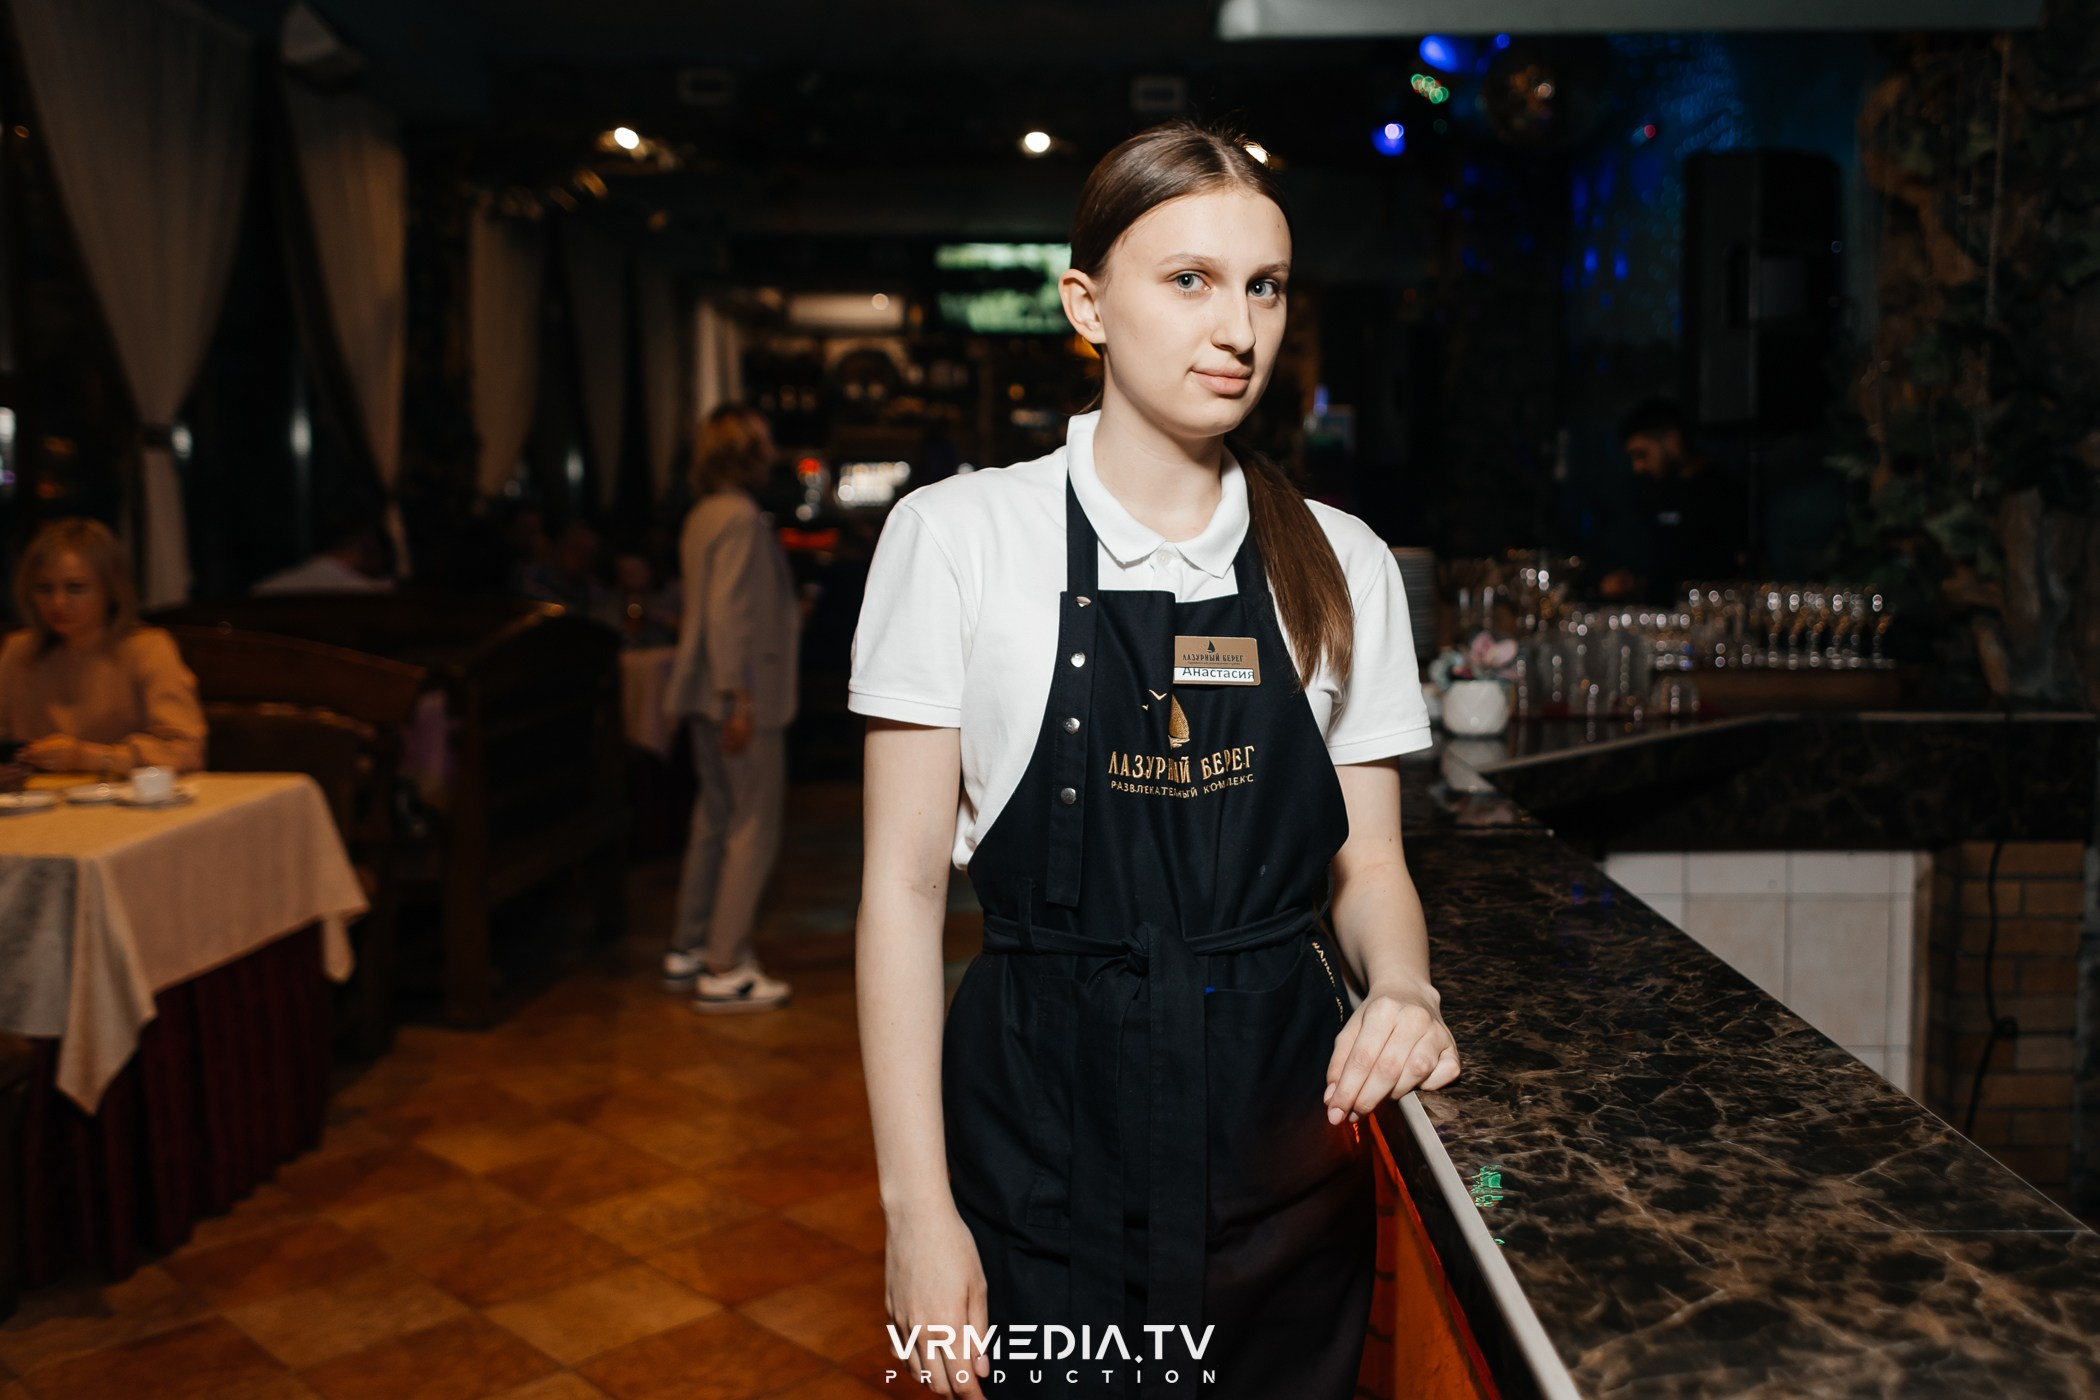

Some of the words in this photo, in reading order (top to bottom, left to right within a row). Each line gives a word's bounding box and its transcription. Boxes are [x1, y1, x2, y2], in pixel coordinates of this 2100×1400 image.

[1183, 653, 1220, 662] ЛАЗУРНЫЙ
[1222, 654, 1244, 662] БЕРЕГ
[1182, 667, 1255, 680] Анастасия
[1200, 745, 1255, 780] БЕРЕГ
[1110, 780, 1198, 799] РАЗВЛЕКАТЕНЫЙ
